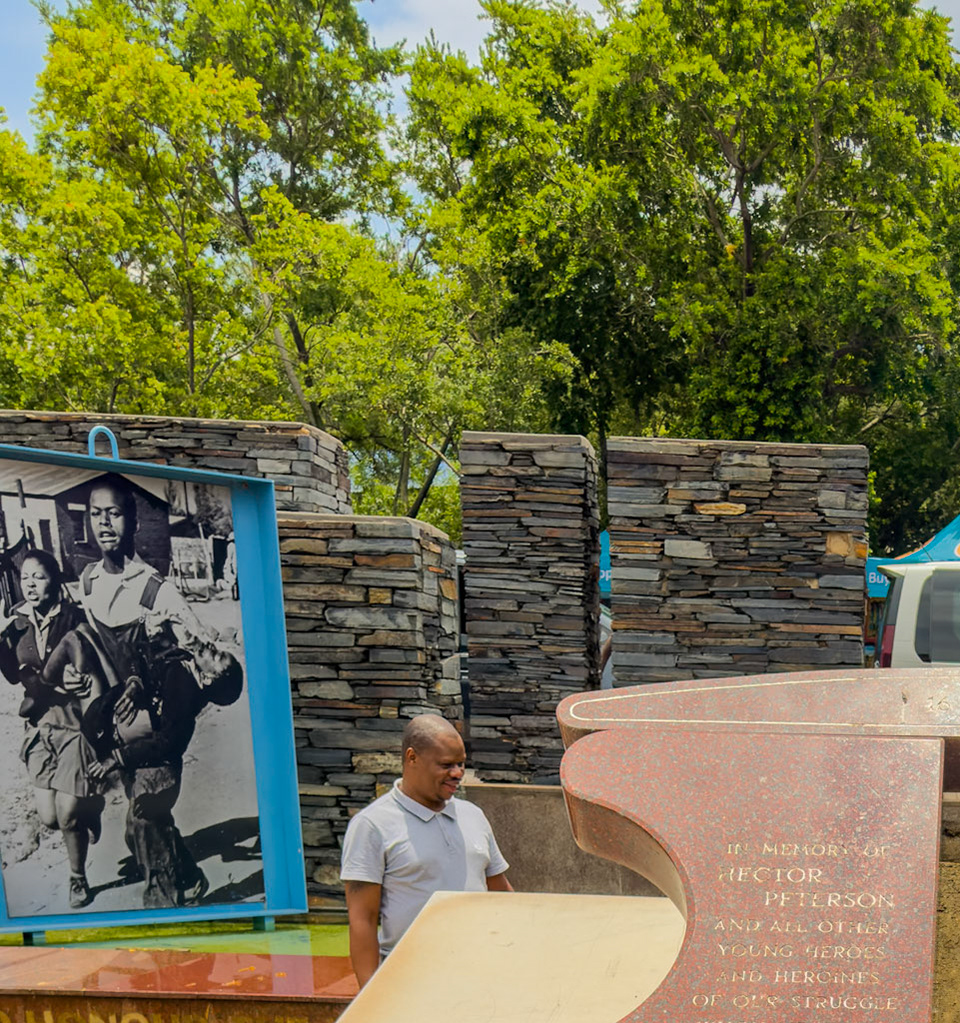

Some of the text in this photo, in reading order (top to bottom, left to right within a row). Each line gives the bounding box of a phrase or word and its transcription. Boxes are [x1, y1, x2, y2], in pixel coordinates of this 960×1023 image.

[927, 696, 951, 712] 16
[727, 843, 890, 858] IN MEMORY OF
[719, 866, 823, 883] HECTOR
[765, 891, 895, 909] PETERSON
[714, 919, 889, 935] AND ALL OTHER
[718, 944, 886, 960] YOUNG HEROES
[716, 970, 880, 984] AND HEROINES
[692, 994, 898, 1010] OF OUR STRUGGLE
